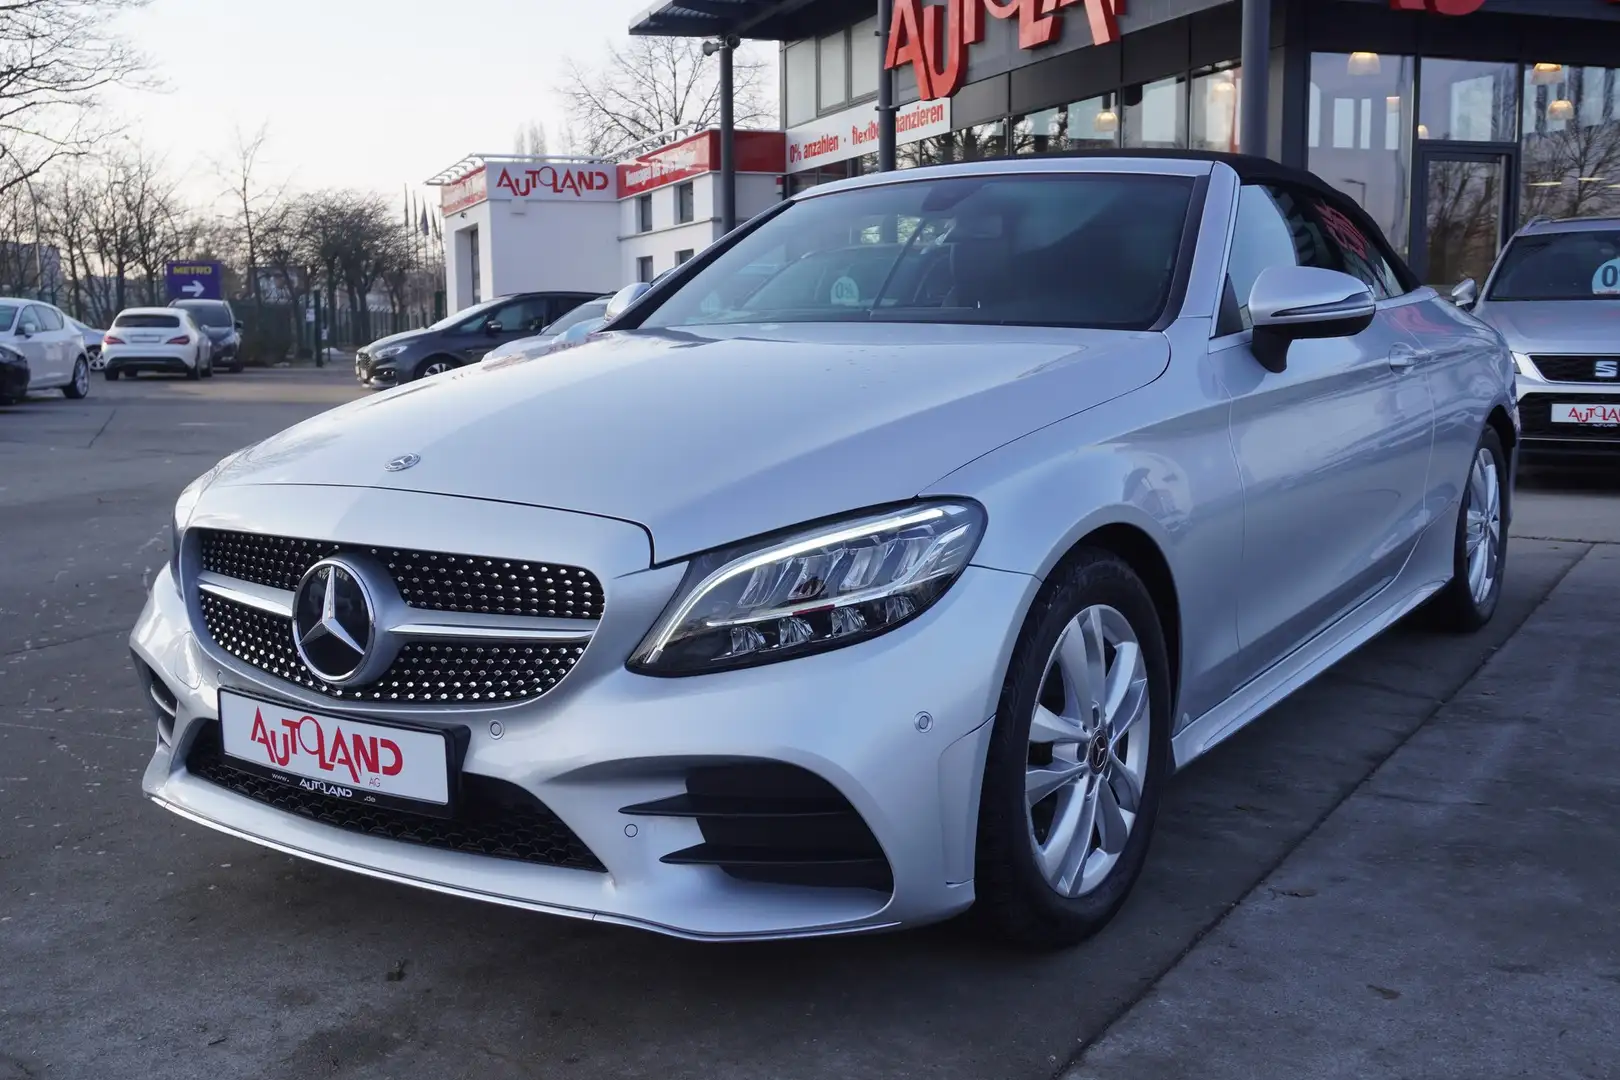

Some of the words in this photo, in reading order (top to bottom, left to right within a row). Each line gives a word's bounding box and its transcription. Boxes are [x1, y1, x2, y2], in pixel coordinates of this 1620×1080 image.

[789, 143, 802, 163] 0%
[803, 134, 839, 161] anzahlen
[496, 165, 609, 197] AUTOLAND
[173, 266, 213, 274] METRO
[1568, 405, 1620, 423] AUTOLA
[250, 706, 404, 784] AUTOLAND
[299, 778, 353, 798] AUTOLAND
[368, 776, 381, 788] AG
